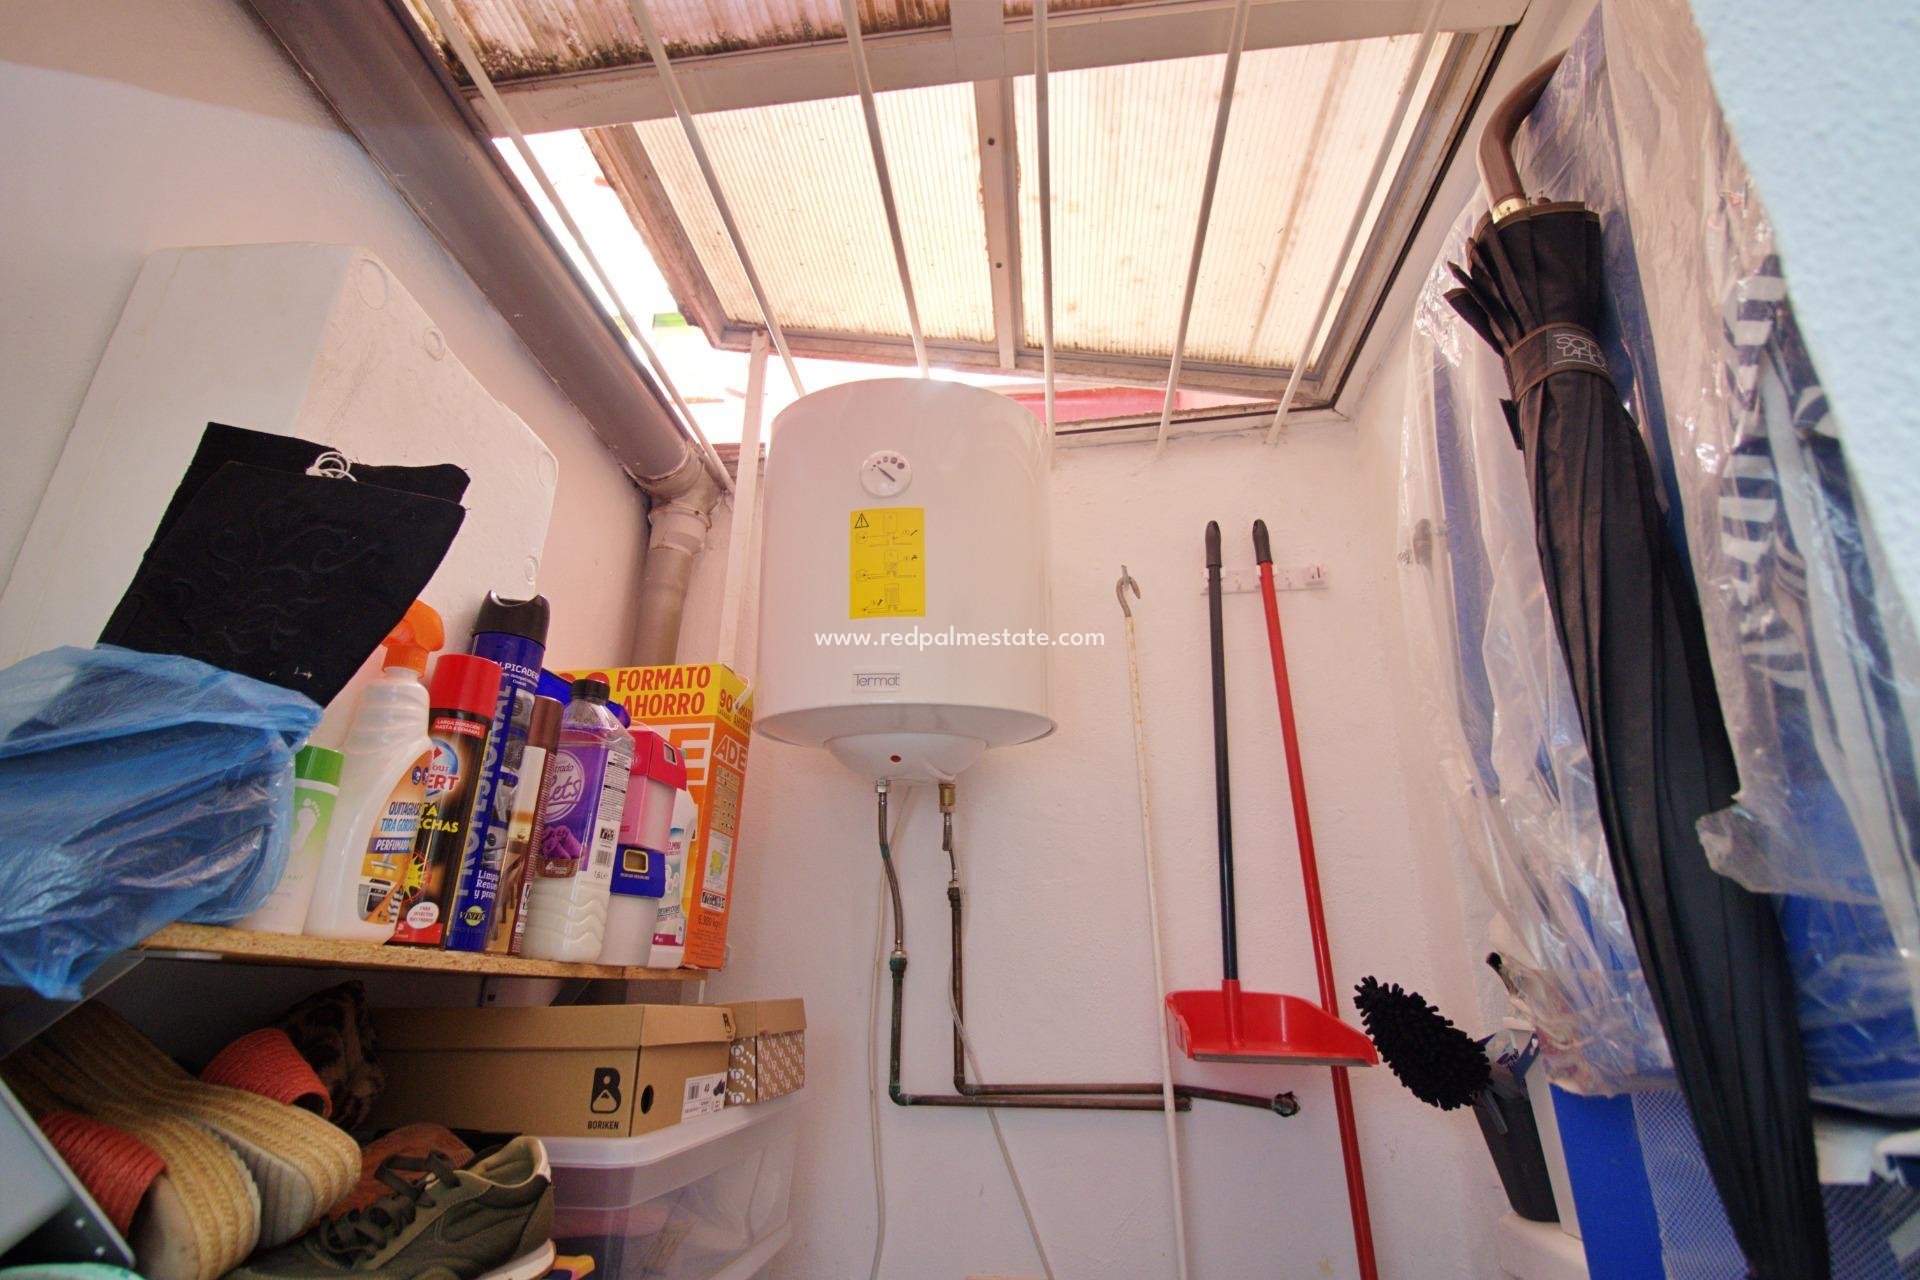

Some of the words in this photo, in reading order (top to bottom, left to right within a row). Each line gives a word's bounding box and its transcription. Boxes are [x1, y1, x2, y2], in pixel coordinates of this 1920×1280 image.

[616, 665, 711, 692] FORMATO
[624, 692, 705, 717] AHORRO
[720, 688, 732, 713] 90
[420, 802, 438, 816] TA
[421, 818, 459, 833] CHAS
[474, 889, 480, 899] y
[587, 1120, 620, 1130] BORIKEN
